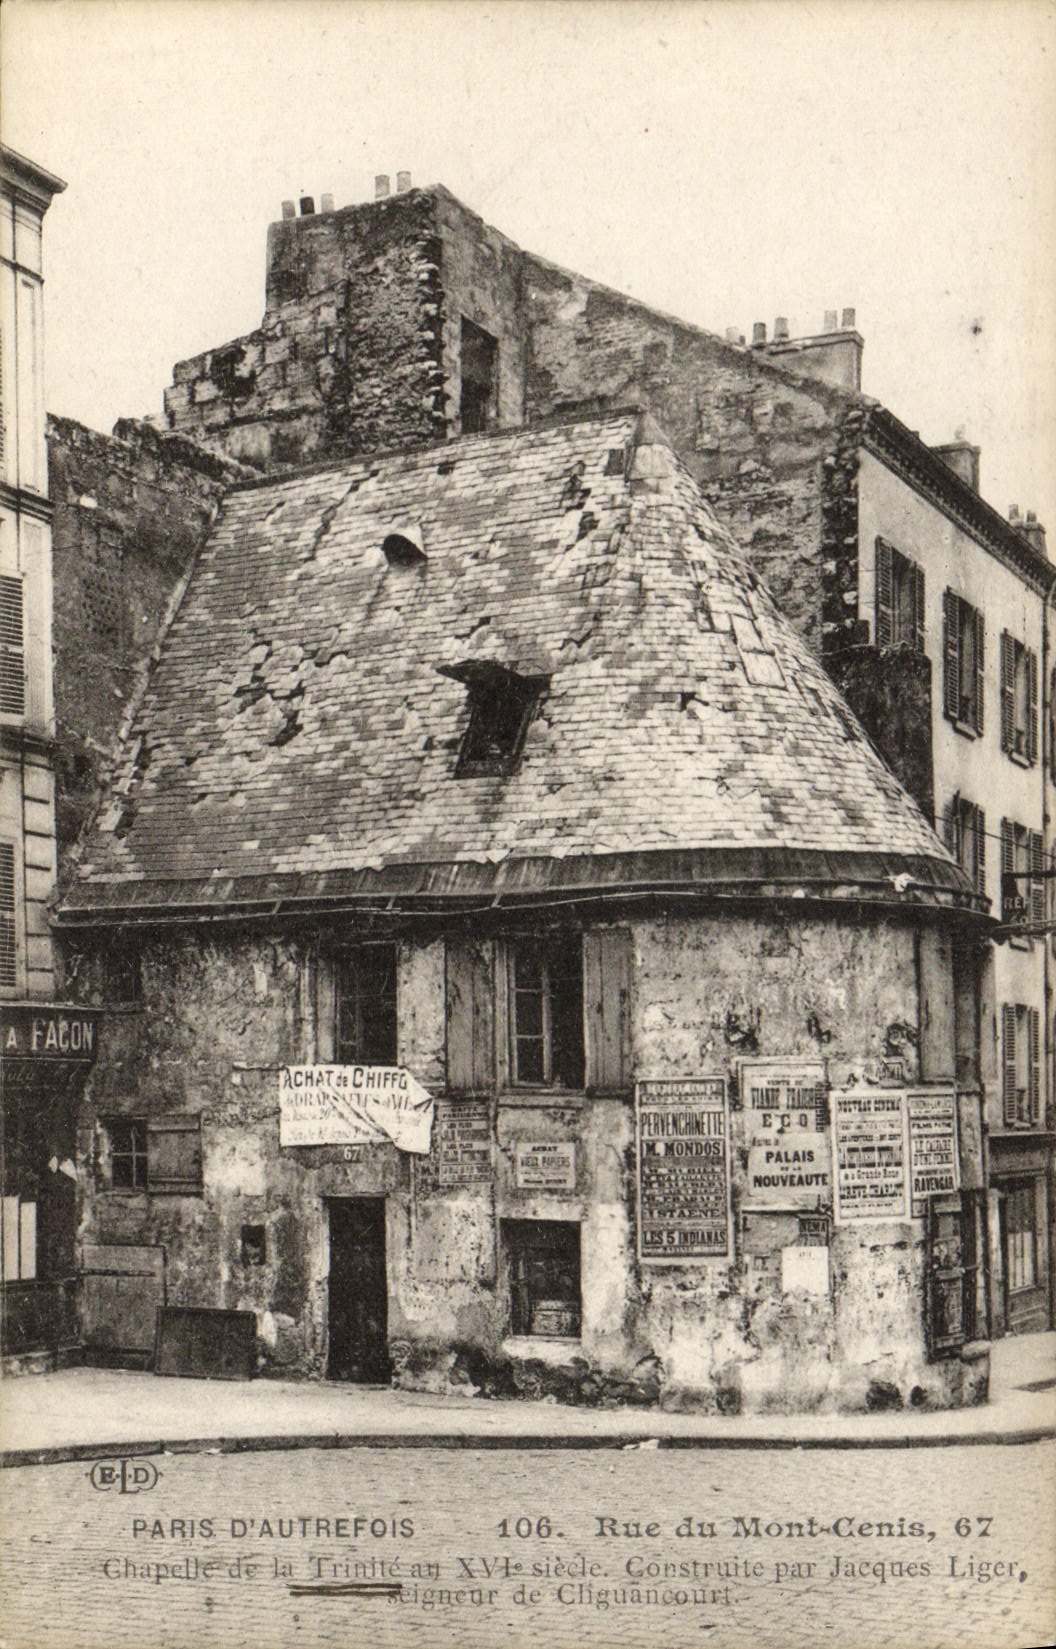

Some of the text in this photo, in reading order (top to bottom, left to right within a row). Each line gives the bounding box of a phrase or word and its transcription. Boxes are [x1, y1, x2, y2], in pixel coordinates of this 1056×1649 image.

[283, 1067, 335, 1089] ACHAT
[344, 1146, 361, 1161] 67
[665, 1142, 721, 1156] MONDOS
[765, 1150, 815, 1164] PALAIS
[667, 1231, 676, 1245] 5
